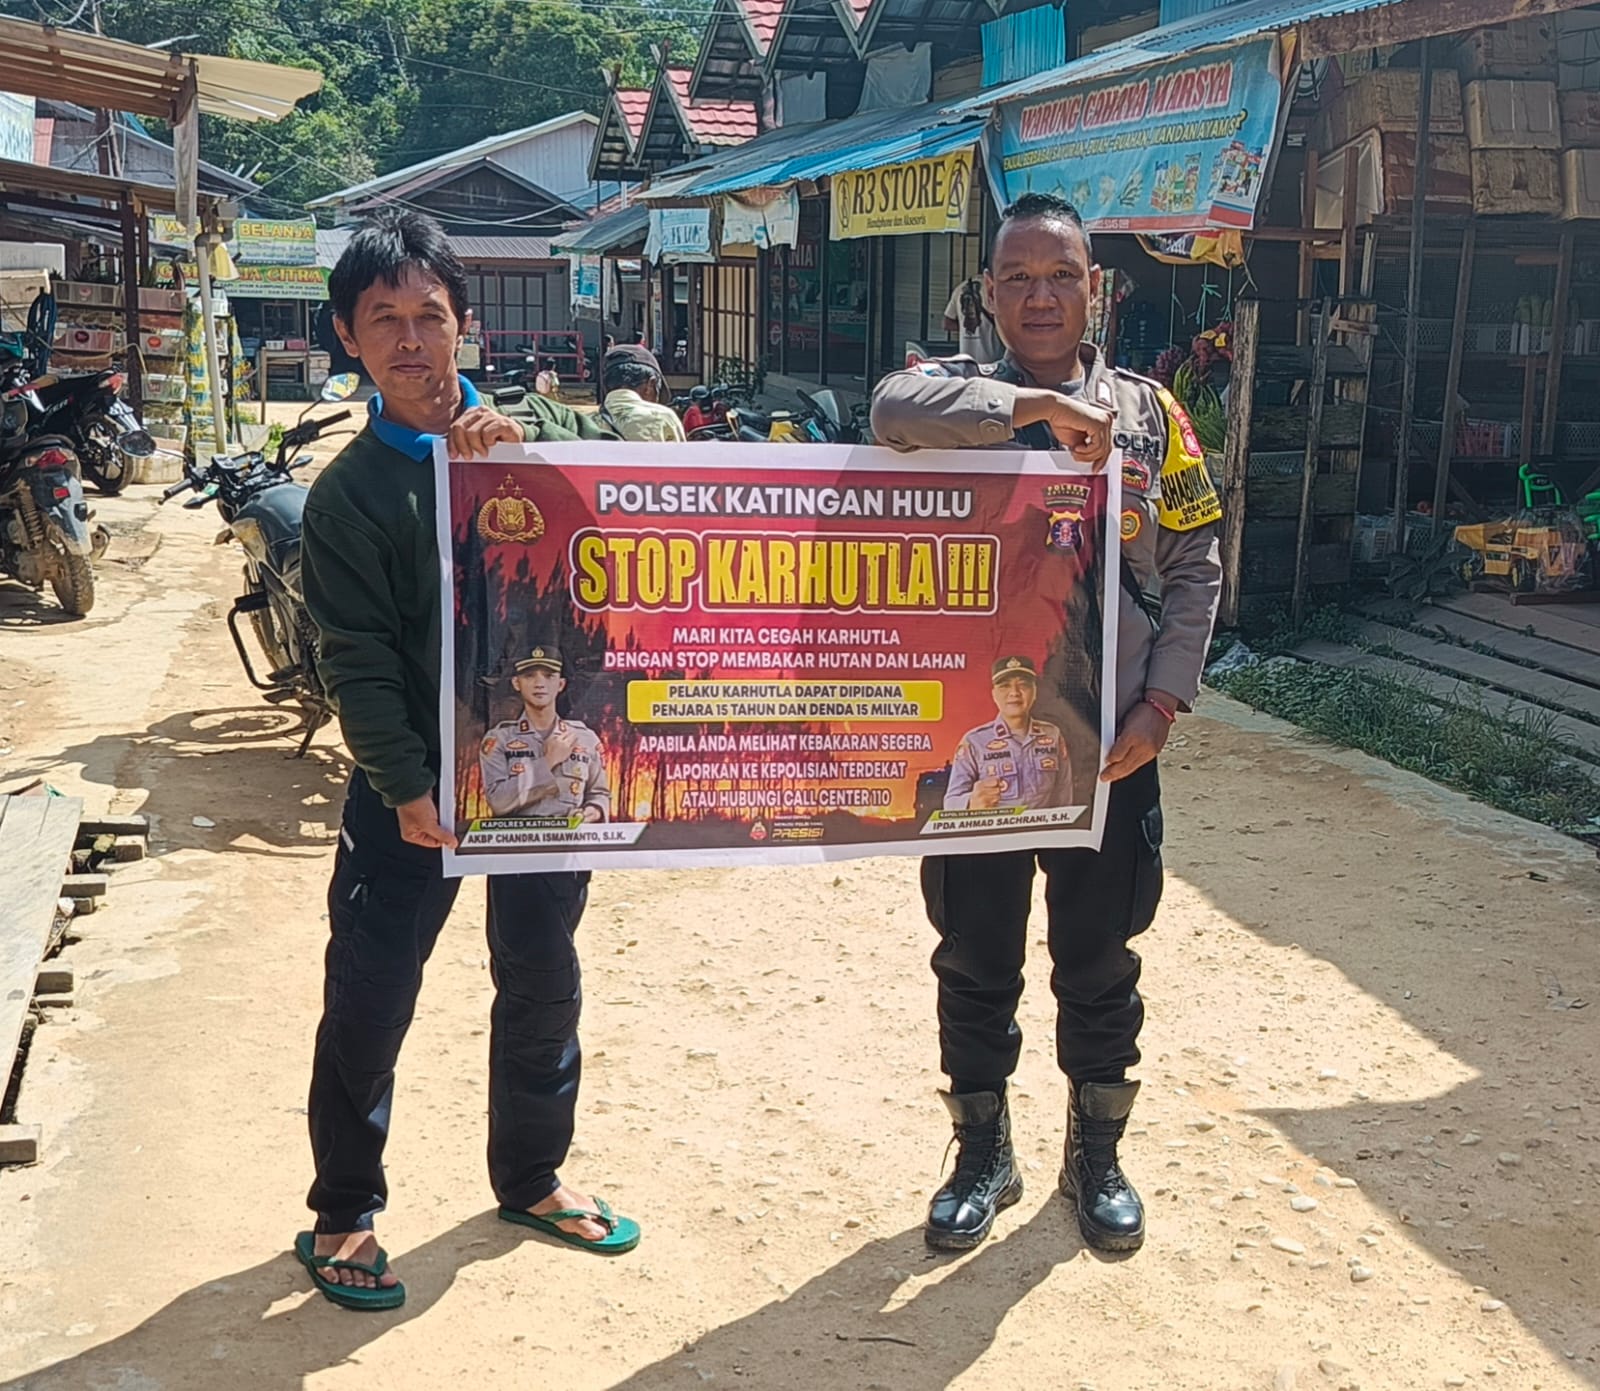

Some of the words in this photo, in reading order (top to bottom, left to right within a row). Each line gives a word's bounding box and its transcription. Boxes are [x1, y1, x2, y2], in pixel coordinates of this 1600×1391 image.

[1020, 97, 1081, 141] WARUNG
[1082, 82, 1148, 129] CAHAYA
[1151, 63, 1232, 115] MARSYA
[852, 172, 876, 215] R3
[880, 161, 946, 213] STORE
[240, 223, 314, 240] BELANJA
[267, 267, 324, 283] CITRA
[1114, 433, 1160, 458] OLRI
[1047, 484, 1084, 492] POLRES
[600, 484, 718, 513] POLSEK
[725, 486, 883, 516] KATINGAN
[892, 489, 971, 518] HULU
[1177, 514, 1199, 527] KEC.
[579, 537, 697, 604] STOP
[707, 539, 936, 606] KARHUTLA
[947, 543, 991, 607] !!!
[673, 628, 715, 644] MARI
[720, 628, 754, 644] KITA
[758, 629, 813, 645] CEGAH
[817, 629, 900, 645] KARHUTLA
[605, 652, 672, 668] DENGAN
[677, 652, 718, 668] STOP
[722, 652, 815, 668] MEMBAKAR
[819, 653, 871, 668] HUTAN
[876, 653, 908, 668] DAN
[913, 653, 966, 669] LAHAN
[669, 686, 719, 697] PELAKU
[723, 686, 792, 697] KARHUTLA
[796, 686, 837, 697] DAPAT
[840, 686, 902, 697] DIPIDANA
[653, 704, 713, 716] PENJARA
[717, 704, 728, 716] 15
[731, 704, 775, 716] TAHUN
[779, 704, 806, 716] DAN
[810, 704, 853, 715] DENDA
[857, 704, 868, 715] 15
[871, 704, 918, 715] MILYAR
[639, 736, 696, 752] APABILA
[698, 736, 737, 751] ANDA
[739, 735, 797, 751] MELIHAT
[800, 735, 878, 751] KEBAKARAN
[881, 735, 931, 750] SEGERA
[666, 763, 739, 780] LAPORKAN
[742, 763, 759, 779] KE
[761, 762, 838, 779] KEPOLISIAN
[841, 762, 906, 778] TERDEKAT
[682, 791, 716, 808] ATAU
[720, 791, 781, 807] HUBUNGI
[784, 791, 816, 806] CALL
[819, 790, 870, 806] CENTER
[872, 790, 890, 805] 110
[526, 820, 567, 828] KATINGAN
[933, 820, 956, 831] IPDA
[959, 819, 994, 829] AHMAD
[997, 815, 1048, 825] SACHRANI,
[1051, 813, 1070, 822] S.H.
[468, 833, 493, 844] AKBP
[495, 833, 541, 843] CHANDRA
[543, 832, 601, 842] ISMAWANTO,
[603, 831, 626, 841] S.I.K.
[772, 828, 825, 838] PRESISI
